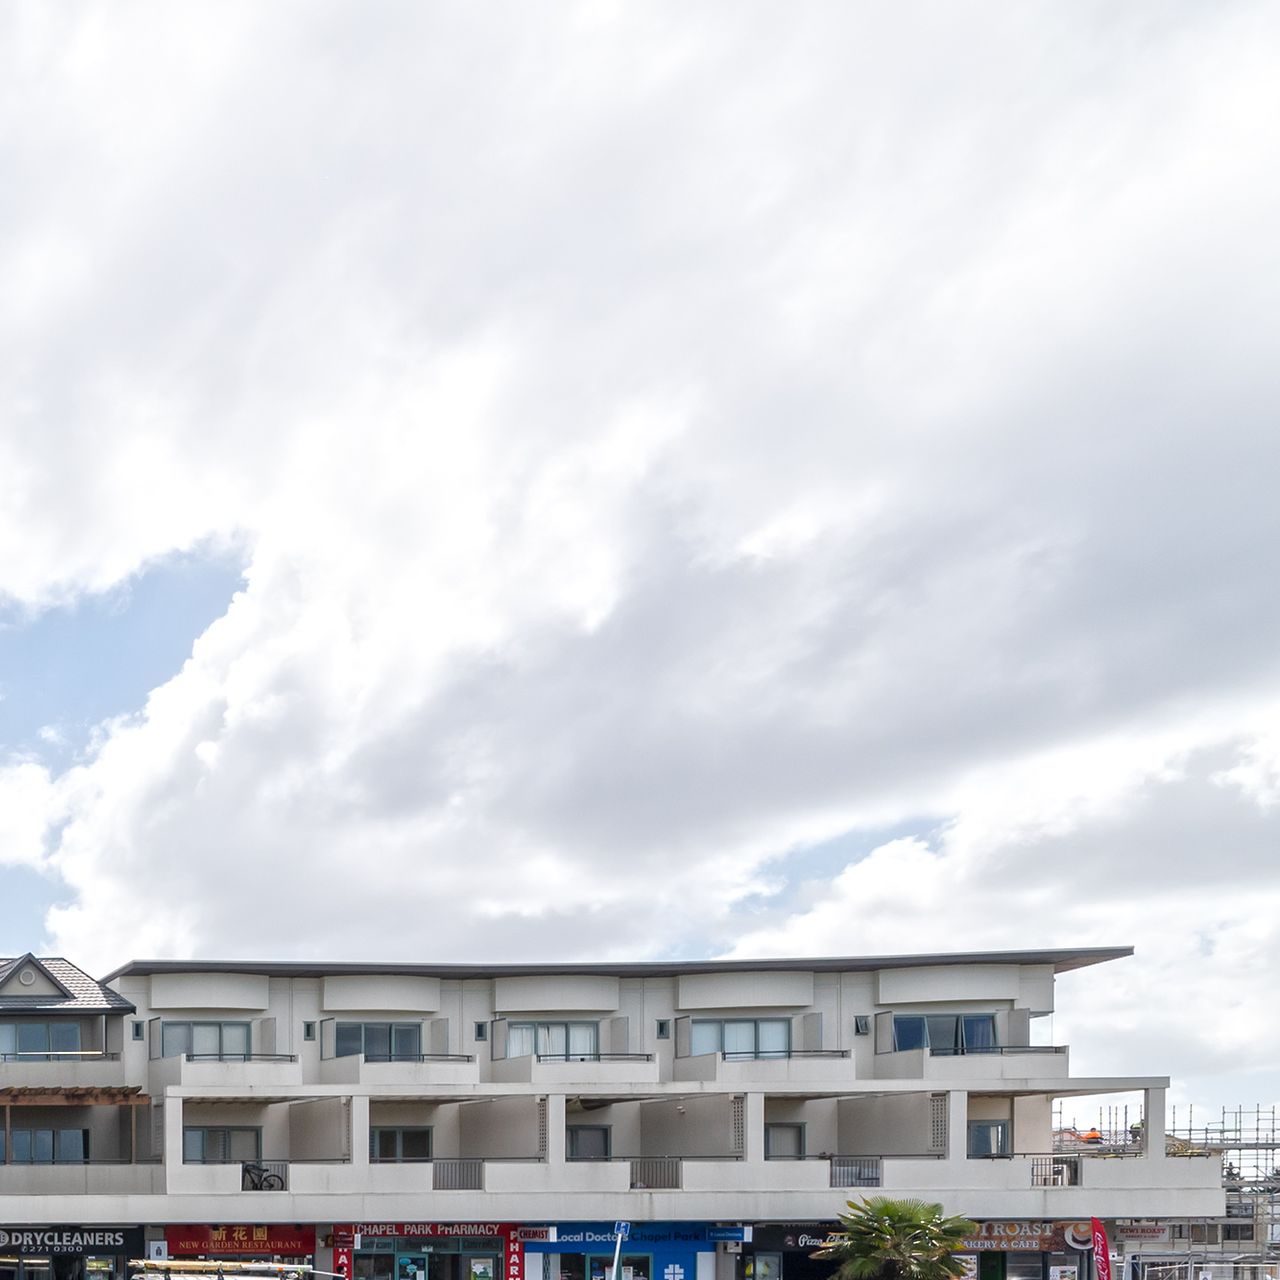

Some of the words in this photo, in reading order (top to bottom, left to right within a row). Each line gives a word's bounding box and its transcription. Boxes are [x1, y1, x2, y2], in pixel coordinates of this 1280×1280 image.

[358, 1224, 399, 1234] CHAPEL
[404, 1224, 433, 1234] PARK
[437, 1224, 500, 1234] PHARMACY
[992, 1223, 1054, 1236] ROAST
[11, 1232, 124, 1245] DRYCLEANERS
[520, 1230, 548, 1239] CHEMIST
[586, 1232, 629, 1242] Doctos
[1011, 1240, 1039, 1248] CAFE
